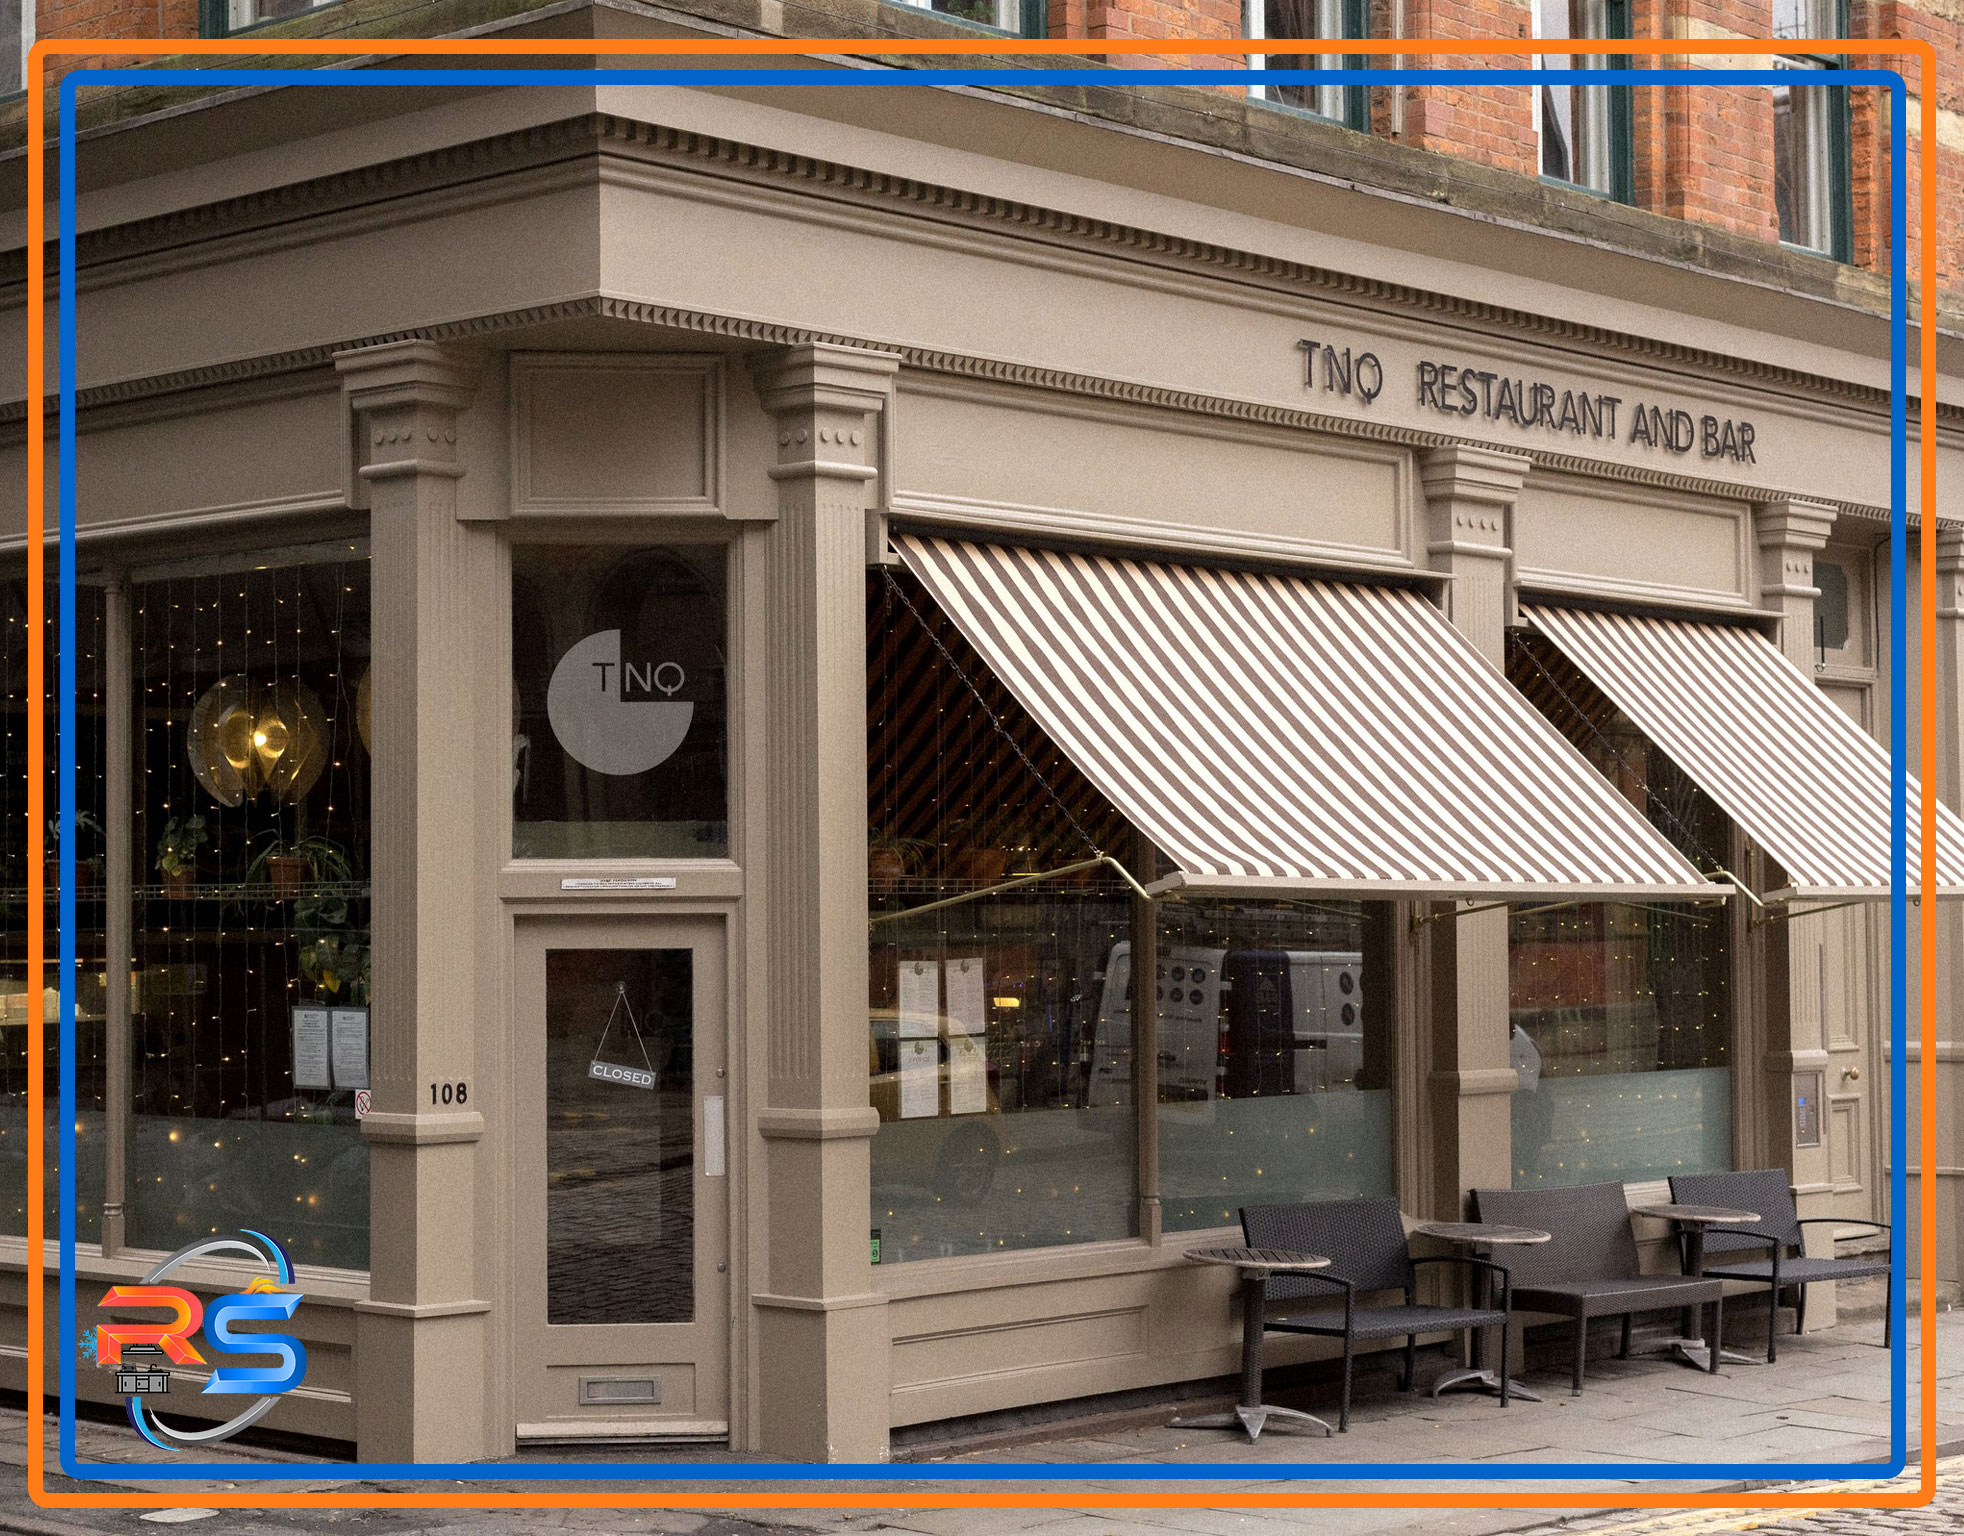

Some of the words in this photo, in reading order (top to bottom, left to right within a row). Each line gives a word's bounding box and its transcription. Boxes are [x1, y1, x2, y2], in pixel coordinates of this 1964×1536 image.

[1298, 339, 1383, 404] TNQ
[1418, 360, 1622, 440] RESTAURANT
[1630, 402, 1694, 453] AND
[1701, 414, 1757, 464] BAR
[592, 661, 685, 696] TNQ
[592, 1065, 652, 1085] CLOSED
[430, 1082, 468, 1105] 108
